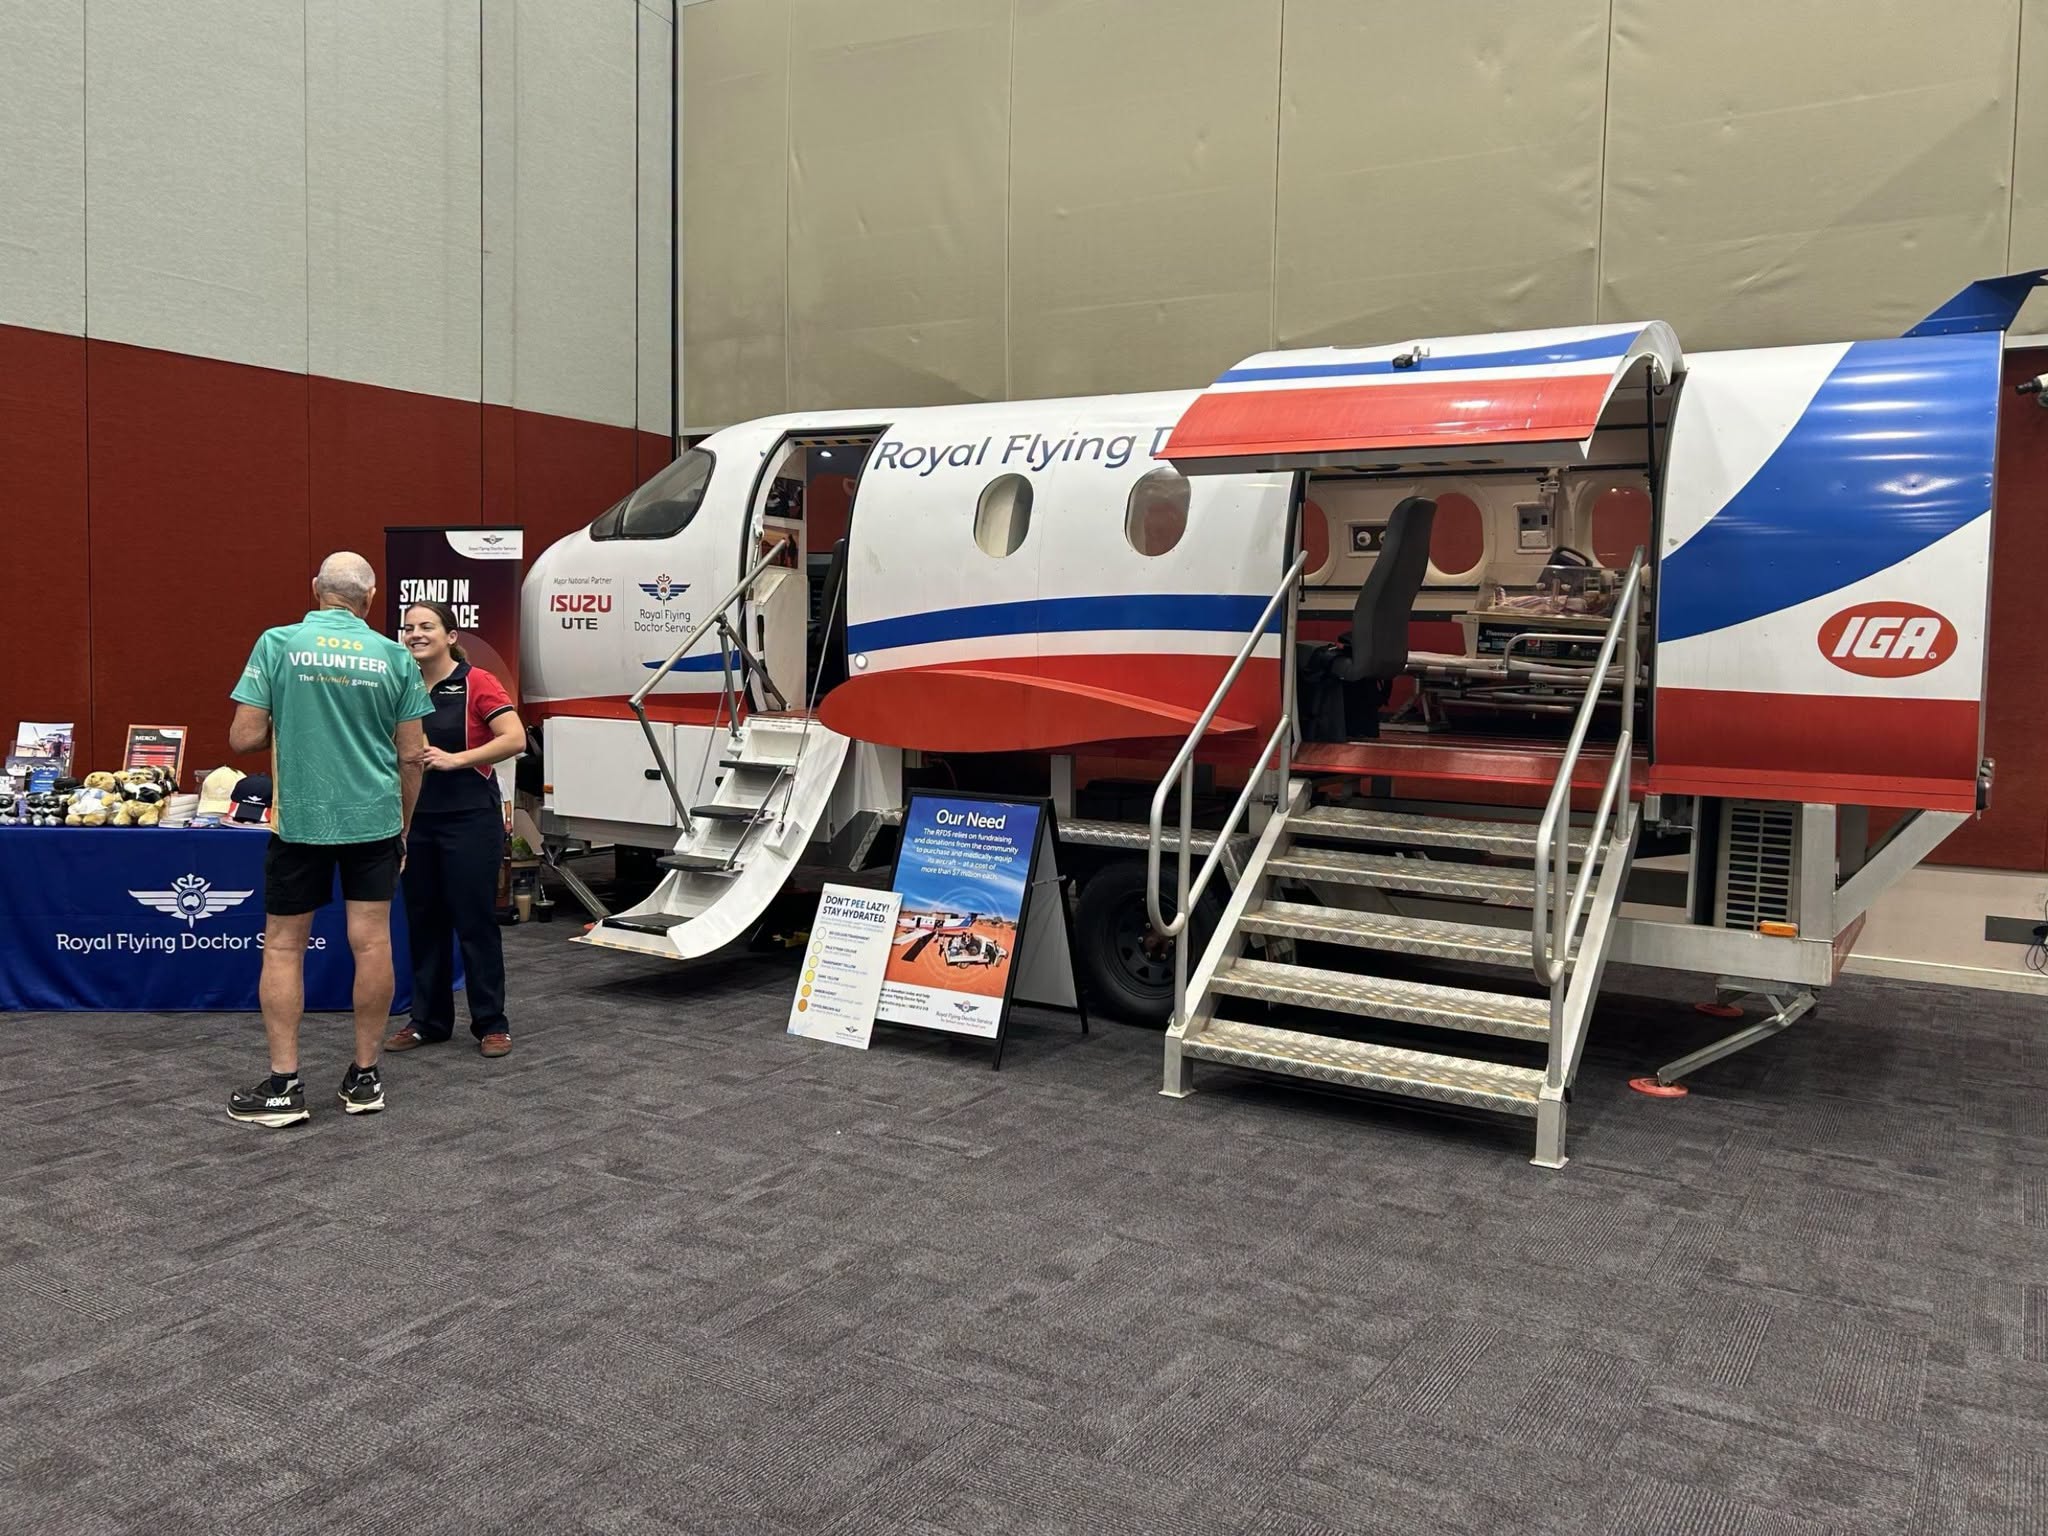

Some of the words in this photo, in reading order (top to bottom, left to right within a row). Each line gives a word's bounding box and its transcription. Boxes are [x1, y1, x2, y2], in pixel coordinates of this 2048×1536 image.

[873, 436, 993, 477] Royal
[1001, 431, 1137, 472] Flying
[591, 576, 612, 584] Partner
[400, 579, 448, 602] STAND
[453, 579, 469, 602] IN
[550, 594, 612, 613] ISUZU
[561, 617, 598, 630] UTE
[639, 609, 663, 621] Royal
[665, 609, 691, 622] Flying
[634, 621, 663, 632] Doctor
[665, 622, 697, 633] Service
[316, 636, 364, 651] 2026
[1831, 616, 1941, 659] IGA
[289, 652, 387, 674] VOLUNTEER
[299, 674, 314, 682] The
[352, 679, 379, 688] games
[936, 809, 965, 826] Our
[966, 812, 1006, 830] Need
[935, 829, 951, 837] RFDS
[952, 830, 968, 838] relies
[978, 834, 1012, 845] fundraising
[923, 848, 950, 857] purchase
[926, 838, 955, 847] donations
[956, 841, 971, 849] from
[971, 842, 982, 850] the
[982, 845, 1019, 855] community
[921, 866, 937, 874] more
[937, 867, 951, 875] than
[825, 895, 851, 906] DON'T
[851, 899, 865, 909] PEE
[866, 901, 890, 913] LAZY!
[823, 906, 841, 917] STAY
[842, 909, 887, 923] HYDRATED.
[56, 934, 112, 954] Royal
[116, 934, 176, 953] Flying
[181, 933, 251, 950] Doctor
[265, 1096, 291, 1107] HOKA
